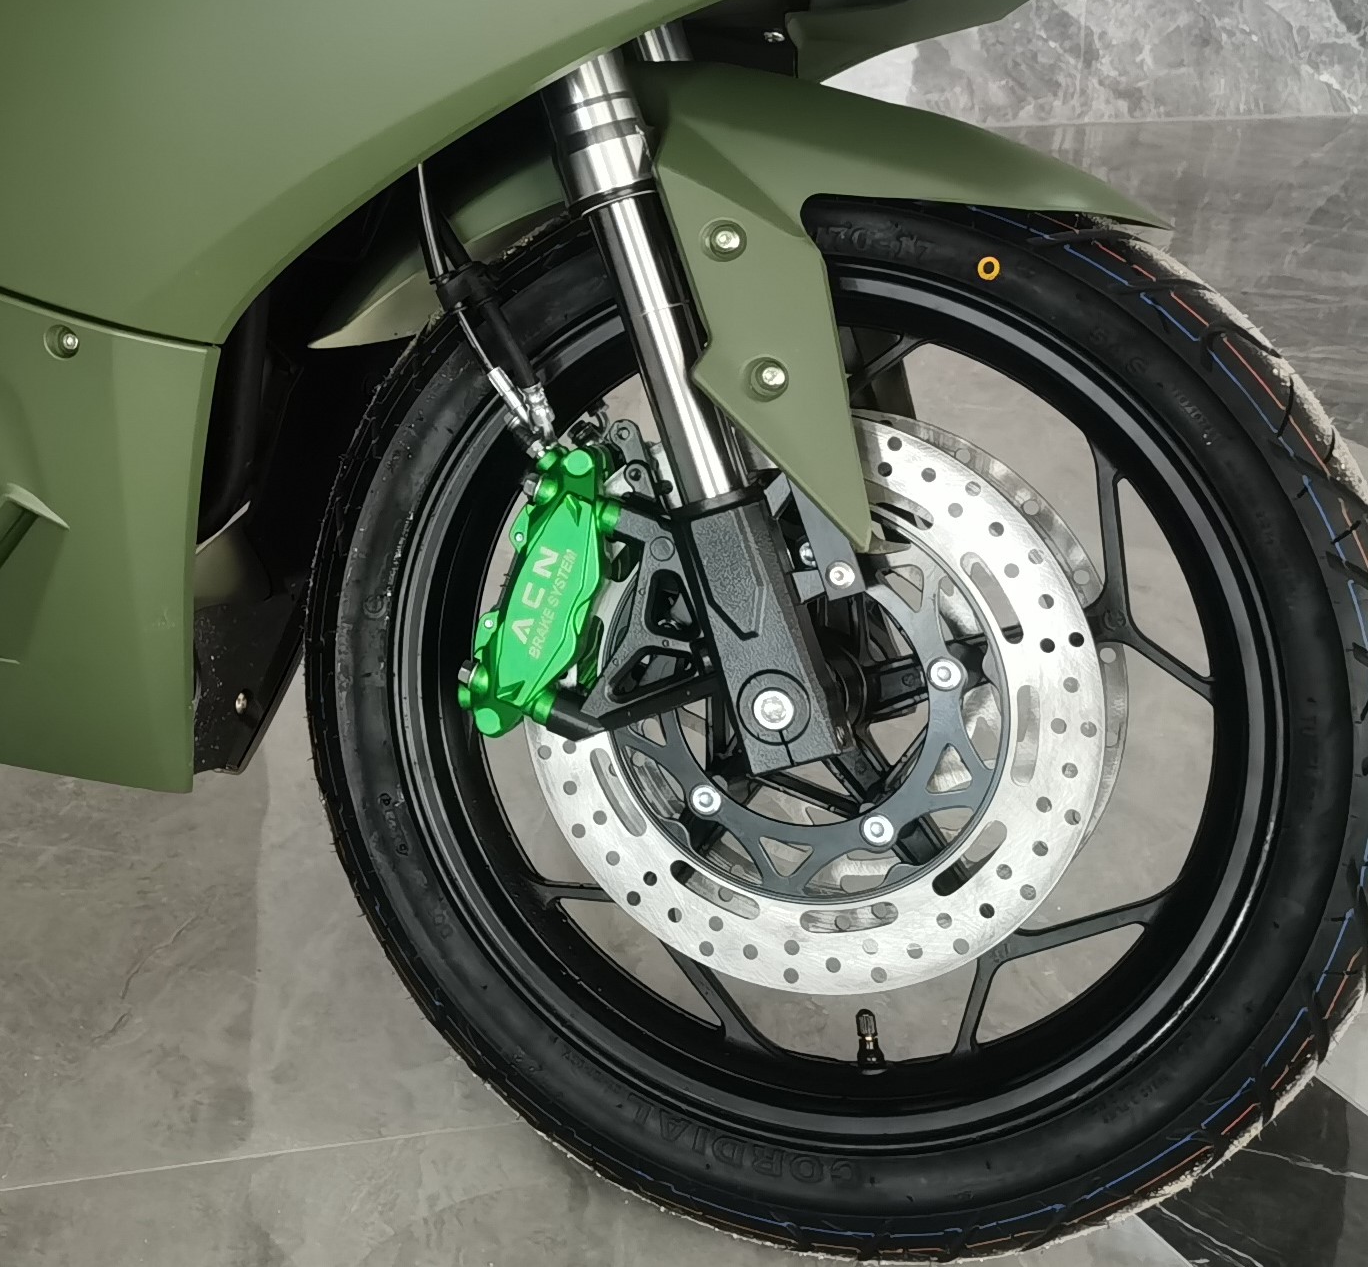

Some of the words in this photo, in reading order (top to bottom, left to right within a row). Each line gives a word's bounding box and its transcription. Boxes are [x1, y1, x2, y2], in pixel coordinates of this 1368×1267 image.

[528, 607, 556, 660] BRAKE
[547, 548, 578, 608] SYSTEM
[628, 1091, 863, 1185] CORDIAL
